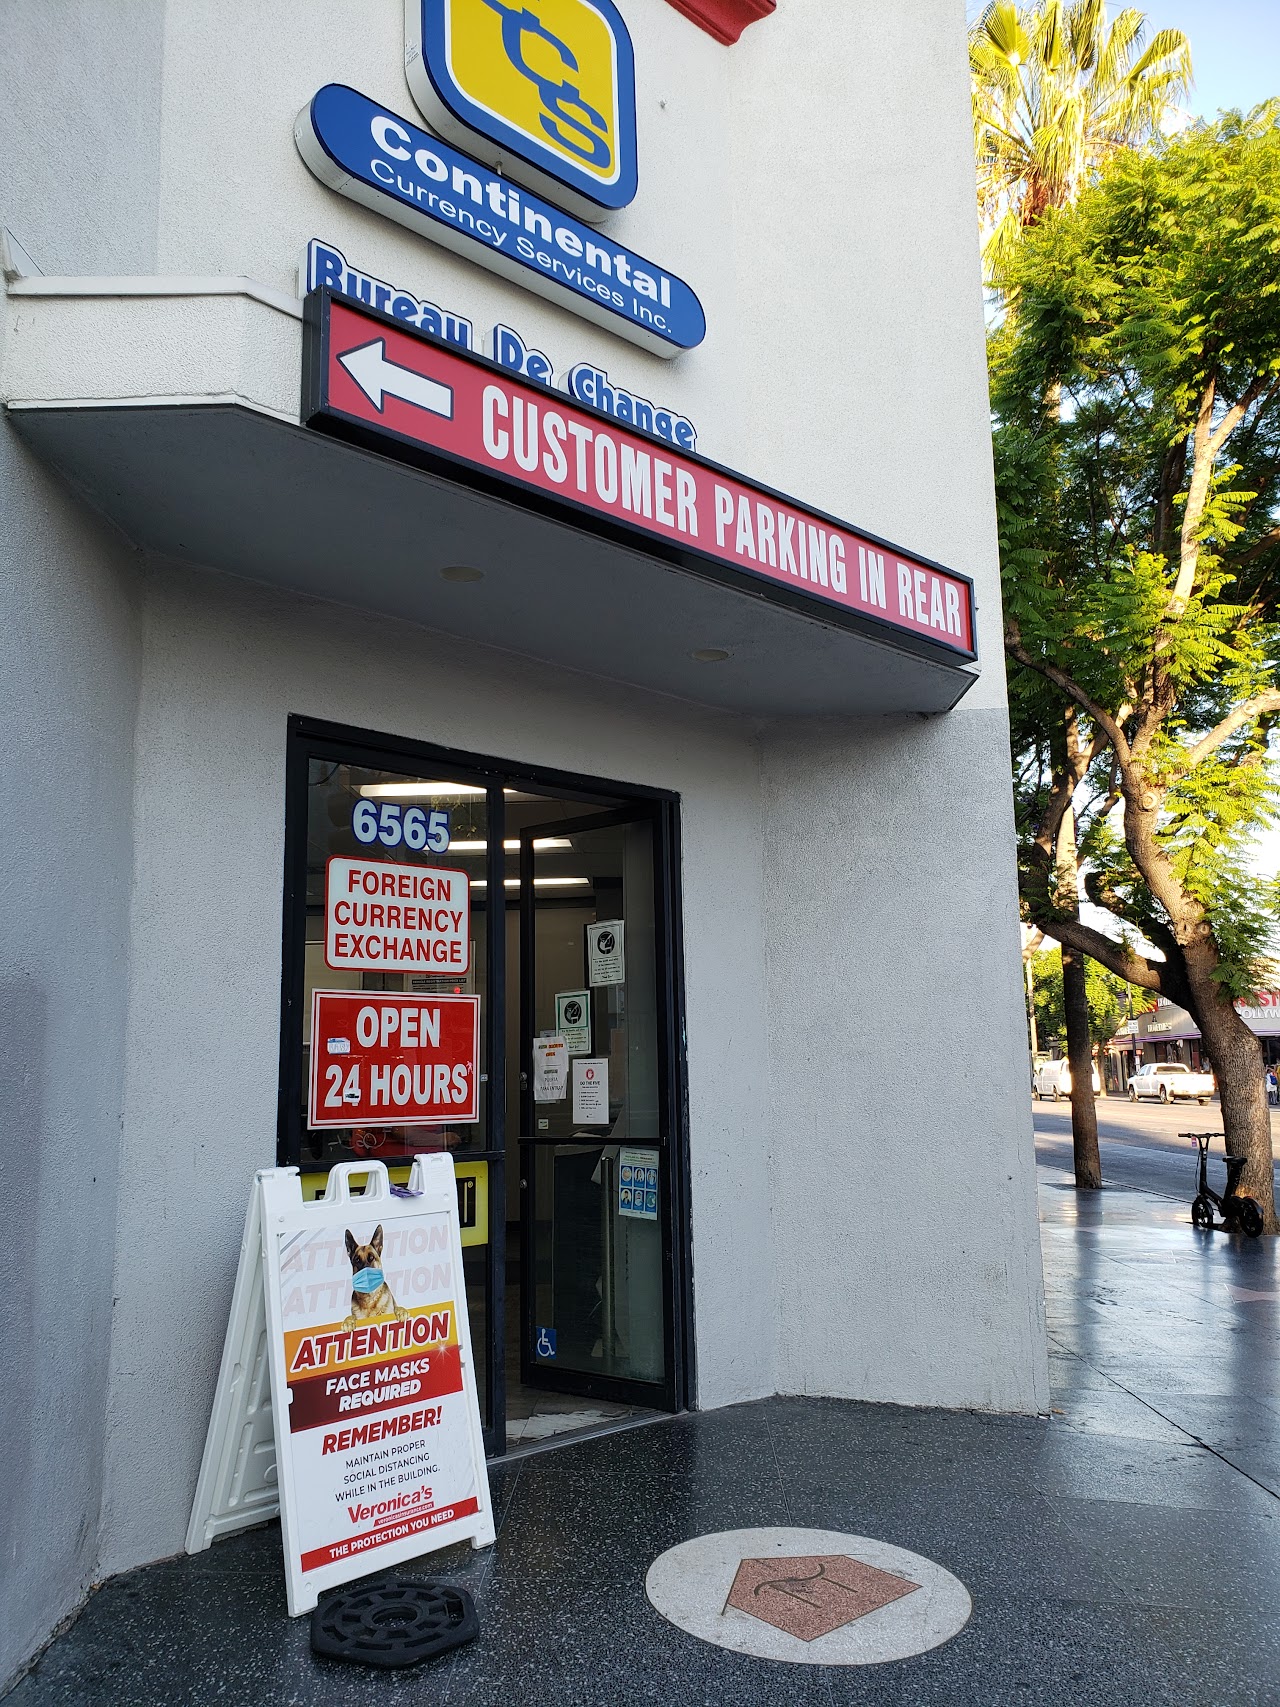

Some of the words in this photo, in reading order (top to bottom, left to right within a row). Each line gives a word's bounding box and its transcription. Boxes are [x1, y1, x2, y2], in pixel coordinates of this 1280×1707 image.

[480, 0, 612, 169] CS
[370, 115, 671, 309] Continental
[371, 159, 507, 246] Currency
[517, 236, 624, 307] Services
[634, 302, 672, 334] Inc.
[315, 245, 469, 350] Bureau
[500, 329, 549, 386] De
[575, 368, 693, 450] Change
[482, 385, 698, 538] CUSTOMER
[716, 484, 846, 595] PARKING
[859, 545, 886, 609] IN
[898, 563, 961, 638] REAR
[352, 799, 450, 853] 6565
[348, 869, 451, 902] FOREIGN
[334, 901, 463, 933] CURRENCY
[335, 933, 462, 964] EXCHANGE
[356, 1005, 440, 1048] OPEN
[324, 1064, 361, 1108] 24
[370, 1061, 468, 1107] HOURS
[284, 1226, 448, 1274] ATTTION
[283, 1262, 451, 1316] ATTTION
[292, 1312, 449, 1371] ATTENTION
[326, 1372, 370, 1396] FACE
[374, 1358, 430, 1383] MASKS
[338, 1379, 421, 1412] REQUIRED
[321, 1405, 443, 1456] REMEMBER!
[345, 1449, 390, 1469] MAINTAIN
[391, 1439, 426, 1456] PROPER
[335, 1485, 365, 1502] WHILE
[367, 1482, 377, 1493] IN
[379, 1476, 396, 1489] THE
[398, 1464, 441, 1483] BUILDING.
[343, 1468, 377, 1485] SOCIAL
[379, 1452, 430, 1475] DISTANCING
[347, 1485, 433, 1524] Veronica's
[329, 1542, 349, 1559] THE
[351, 1525, 409, 1552] PROTECTION
[410, 1518, 430, 1531] YOU
[431, 1508, 455, 1525] NEED
